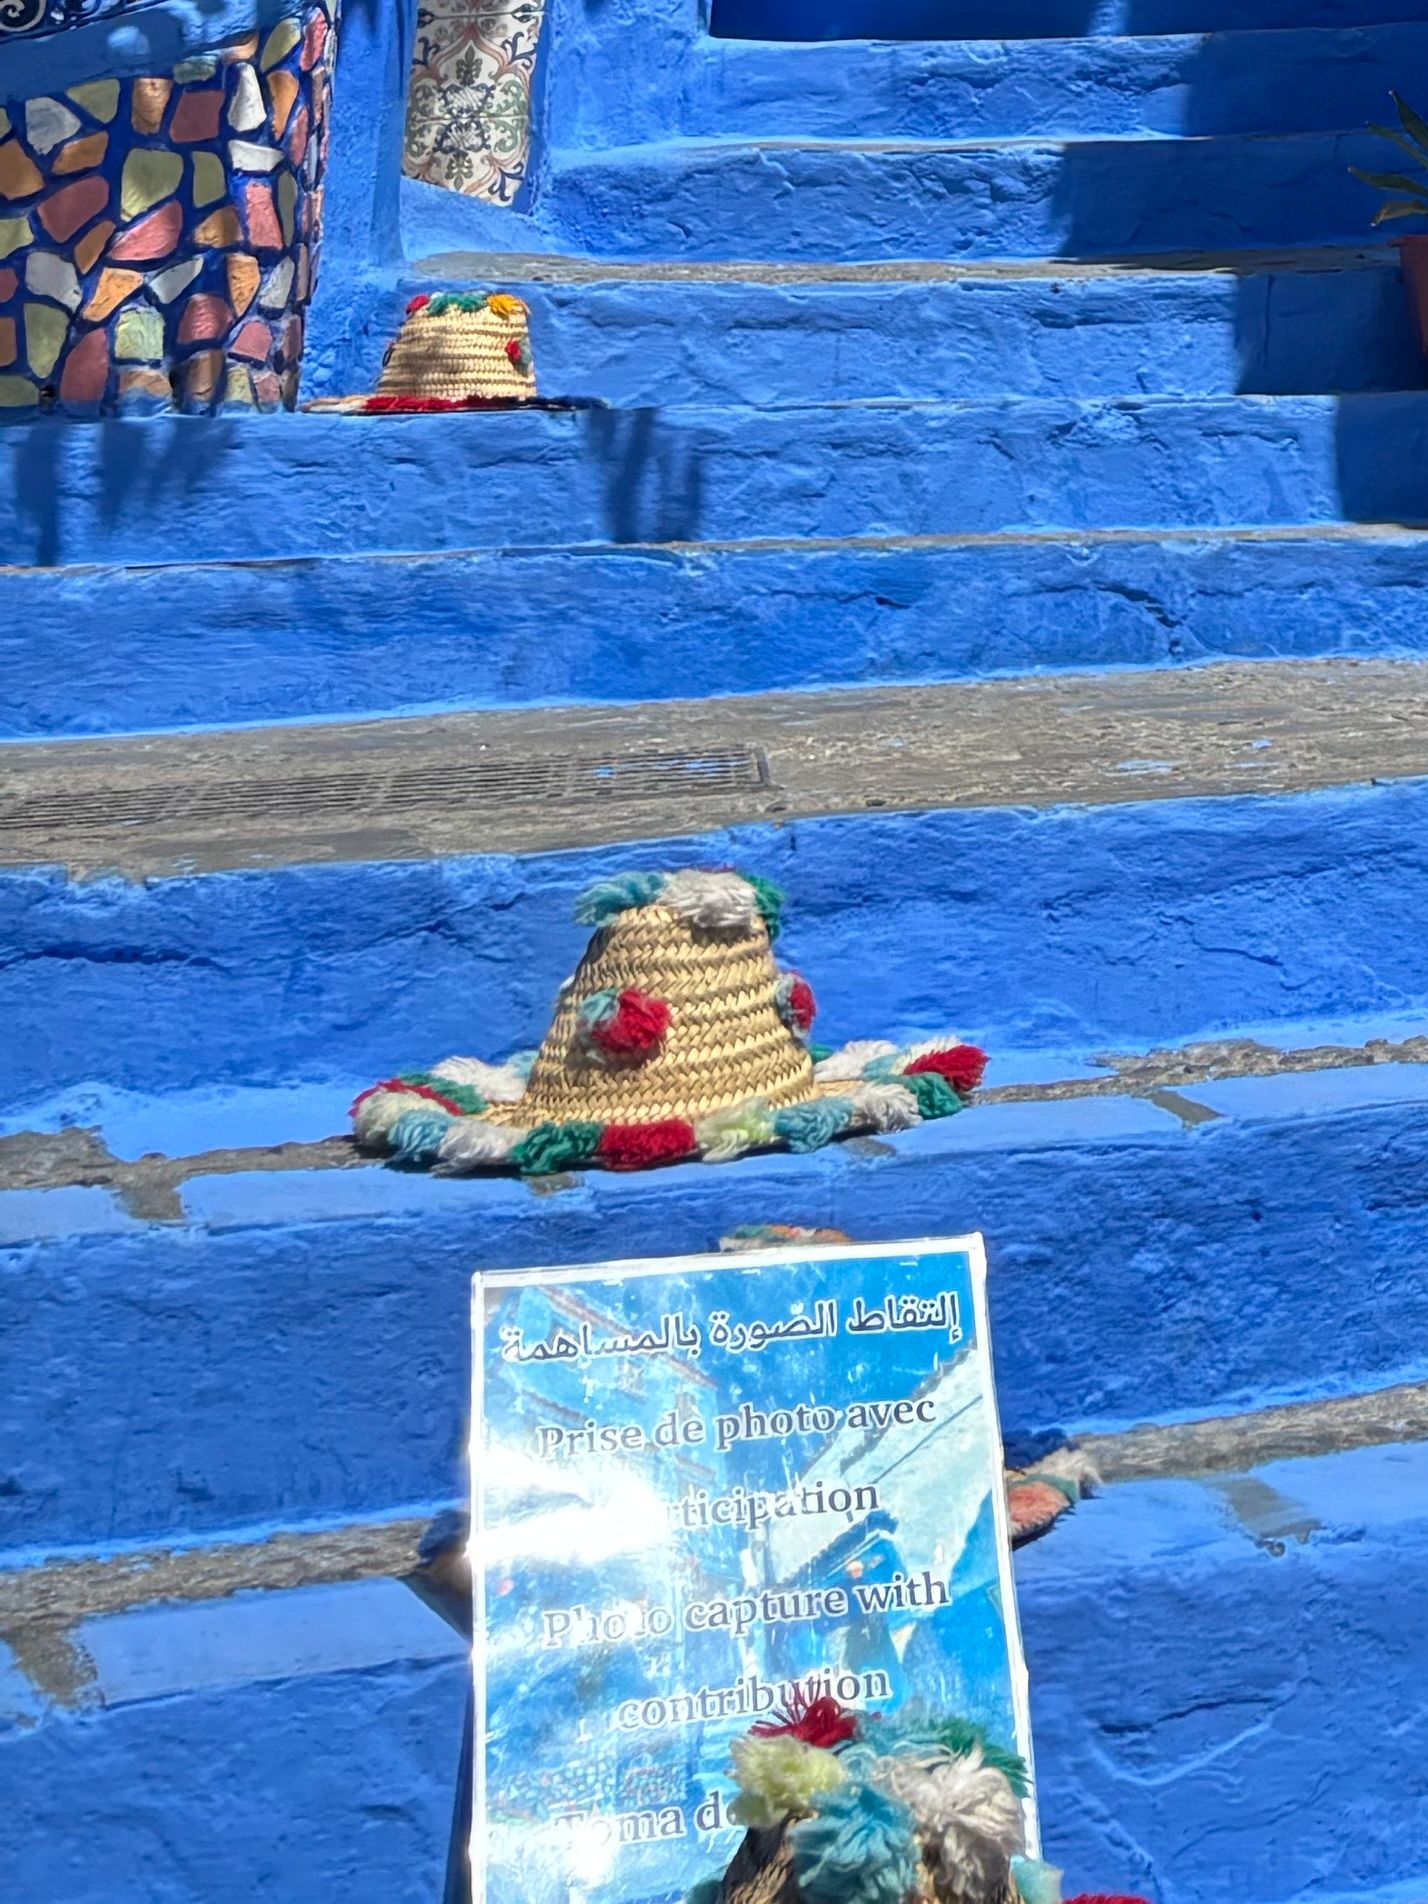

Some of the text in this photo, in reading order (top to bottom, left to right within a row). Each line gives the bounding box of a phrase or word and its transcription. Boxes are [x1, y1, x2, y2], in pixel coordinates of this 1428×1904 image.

[504, 1317, 700, 1360] بالمساهمة
[849, 1295, 959, 1343] إلتقاط
[539, 1400, 937, 1457] Prise de photo avec
[665, 1481, 879, 1530] rticipation
[686, 1588, 844, 1634] capture
[856, 1573, 949, 1607] with
[618, 1667, 889, 1728] contribution
